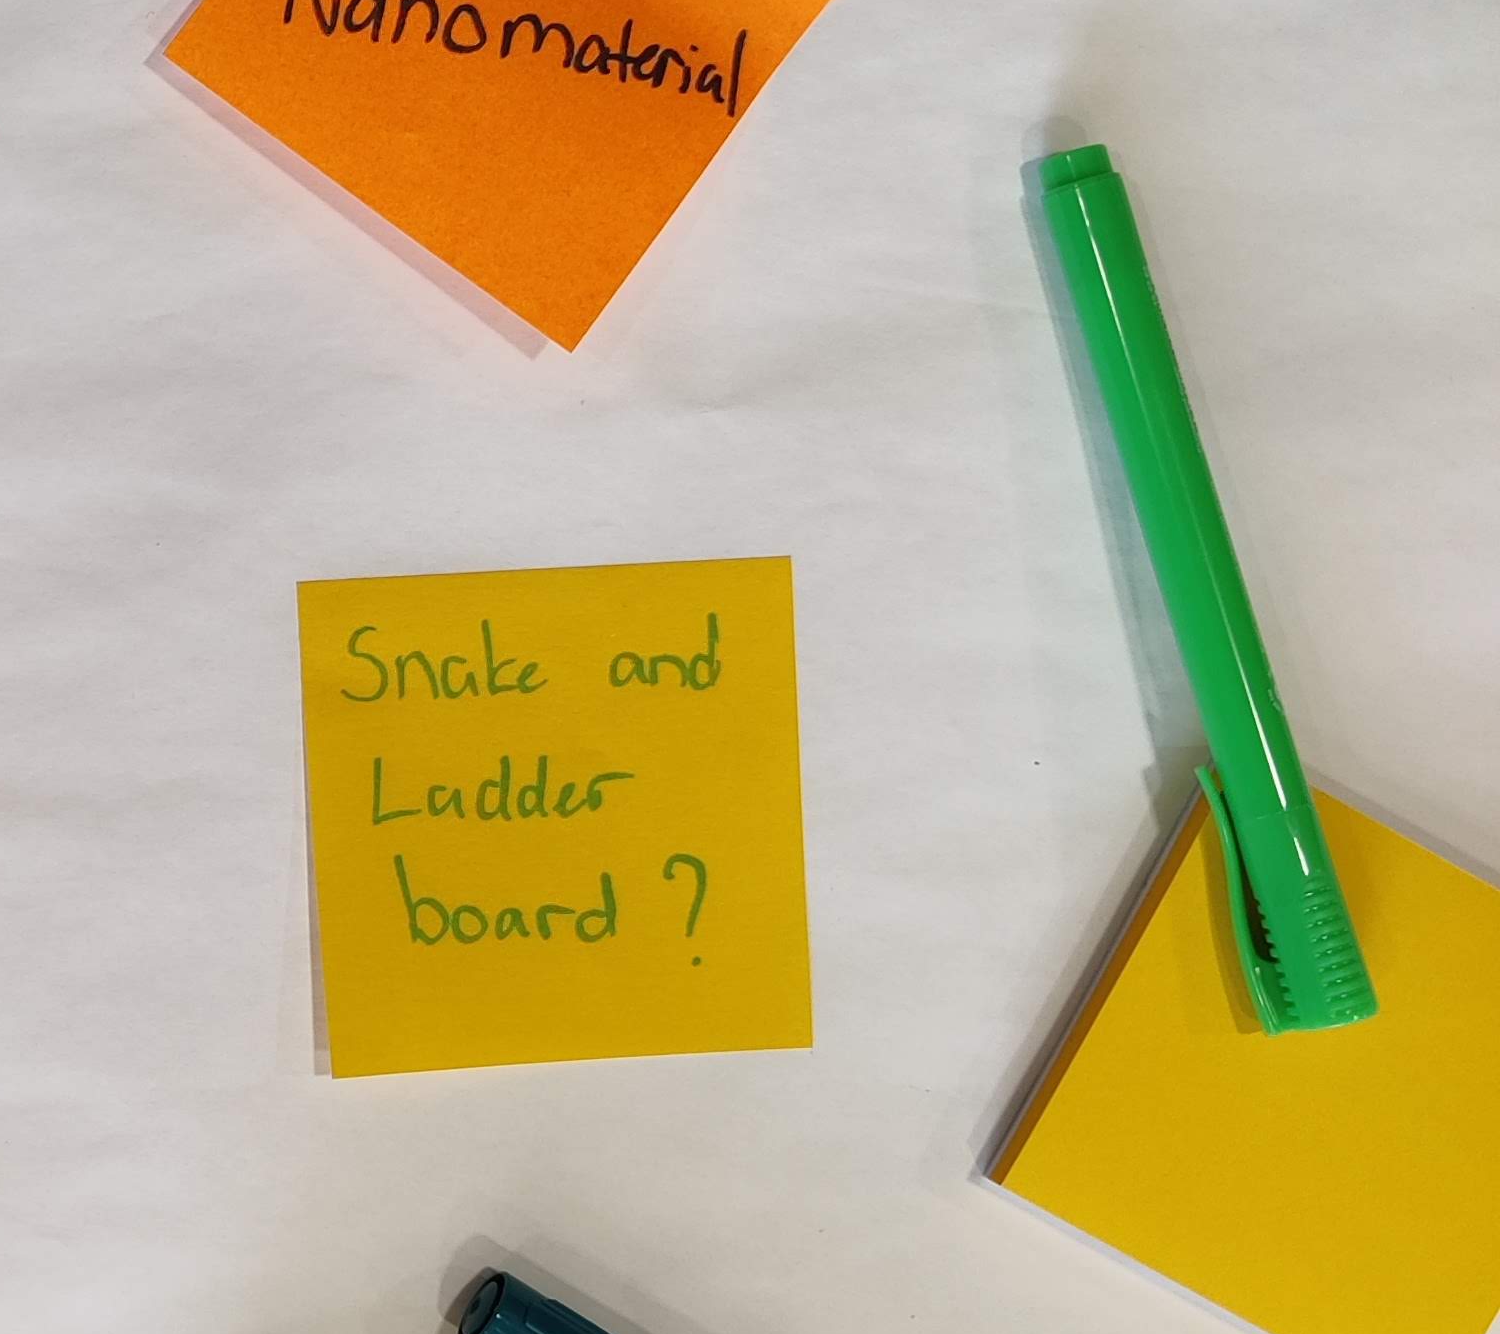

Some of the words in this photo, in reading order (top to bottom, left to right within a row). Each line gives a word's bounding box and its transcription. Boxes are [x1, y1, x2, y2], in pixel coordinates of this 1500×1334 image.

[340, 619, 548, 702] Snake
[609, 612, 721, 690] and
[372, 755, 635, 825] Ladder
